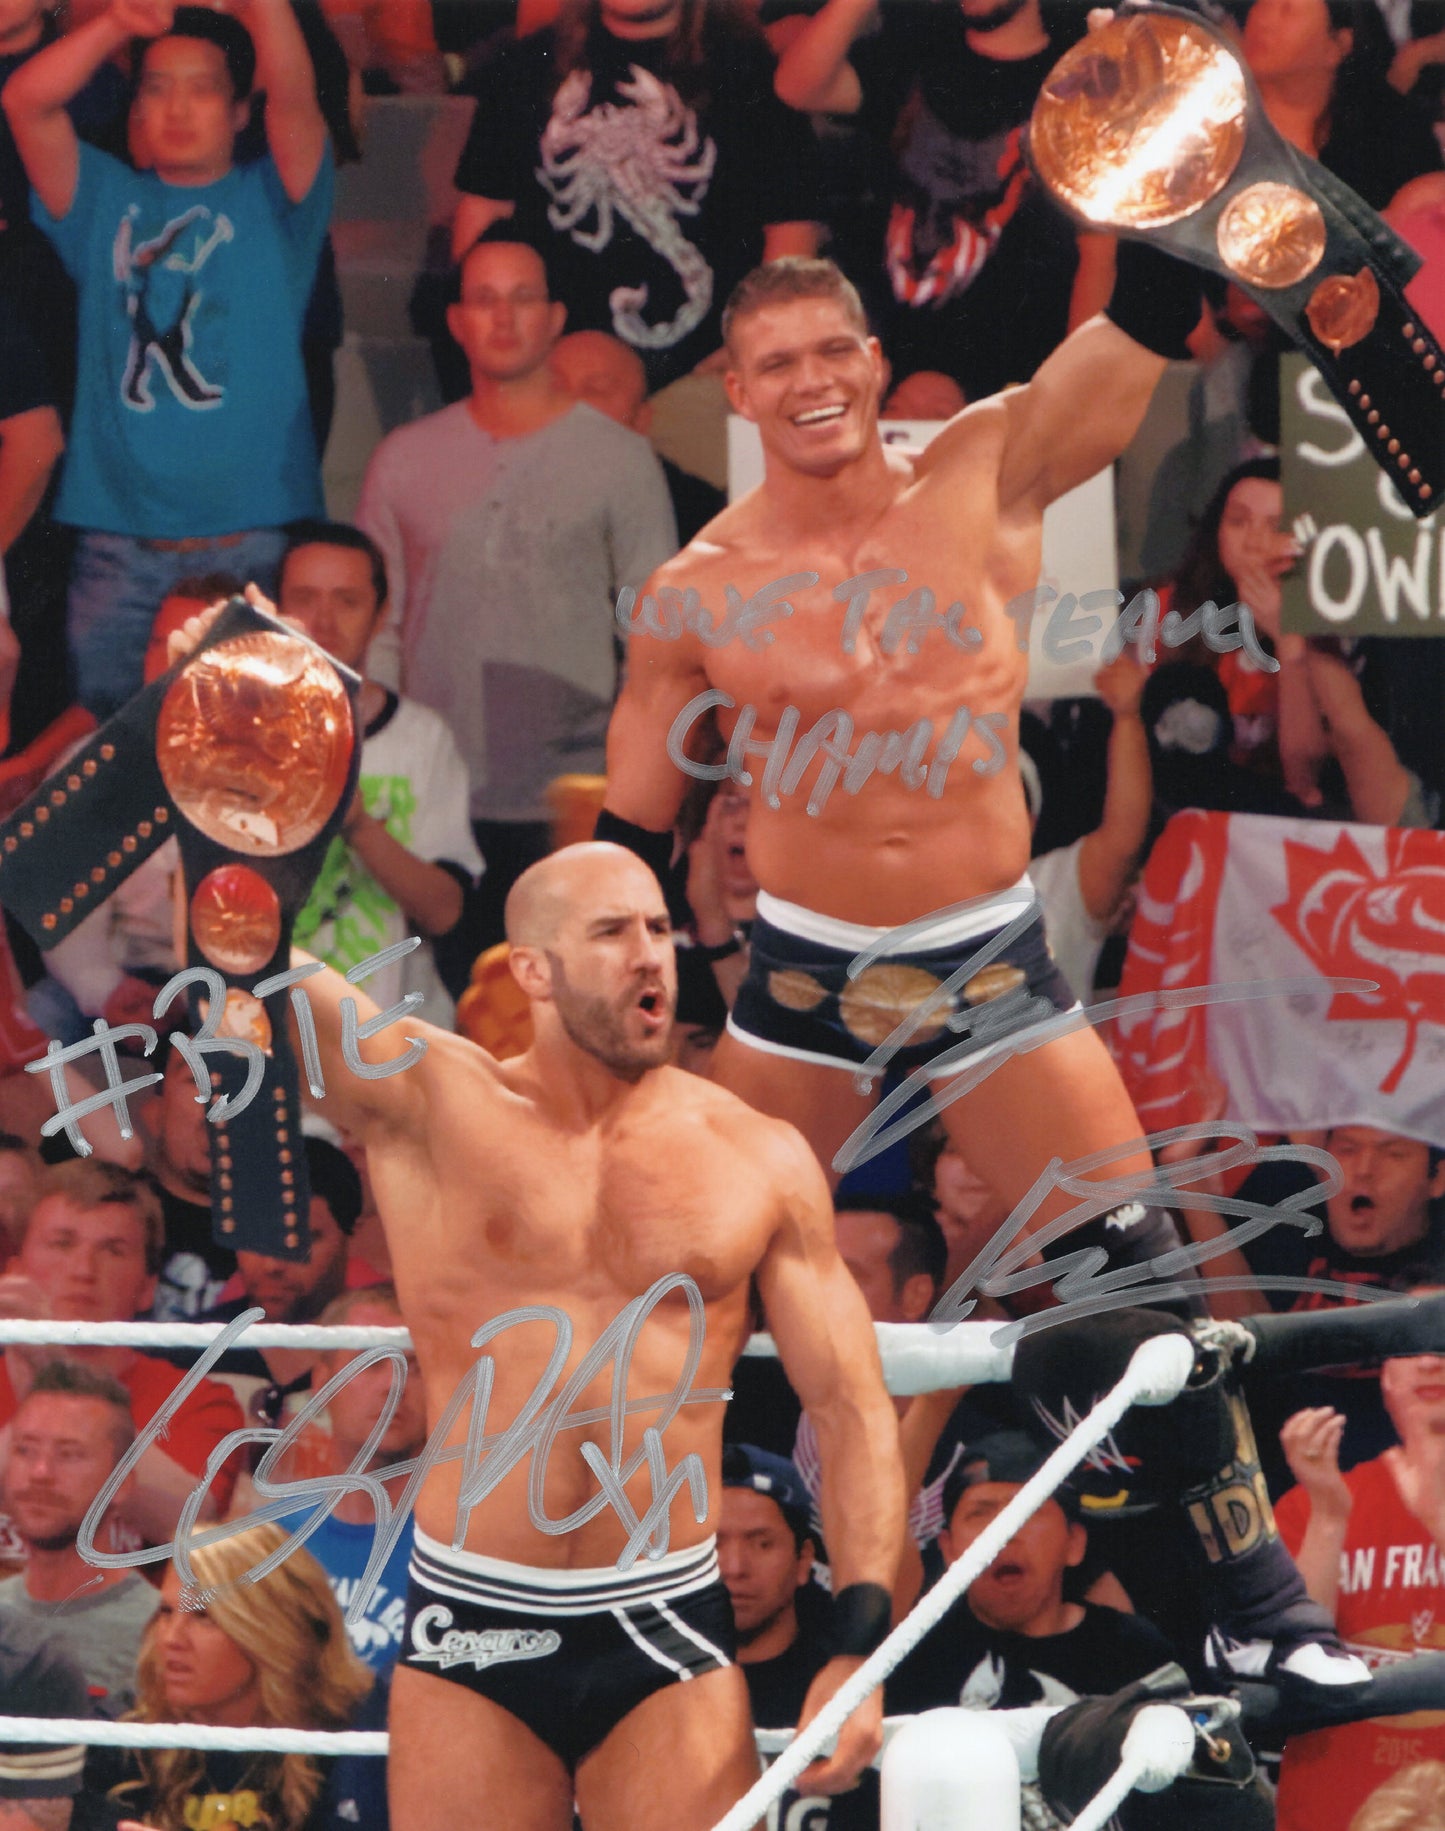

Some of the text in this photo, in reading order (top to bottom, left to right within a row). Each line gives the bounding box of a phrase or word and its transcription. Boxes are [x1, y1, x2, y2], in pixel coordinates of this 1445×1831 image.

[616, 567, 1281, 674] WWE TAG TEAM
[1290, 513, 1445, 624] "OW
[1383, 1544, 1445, 1589] FRA
